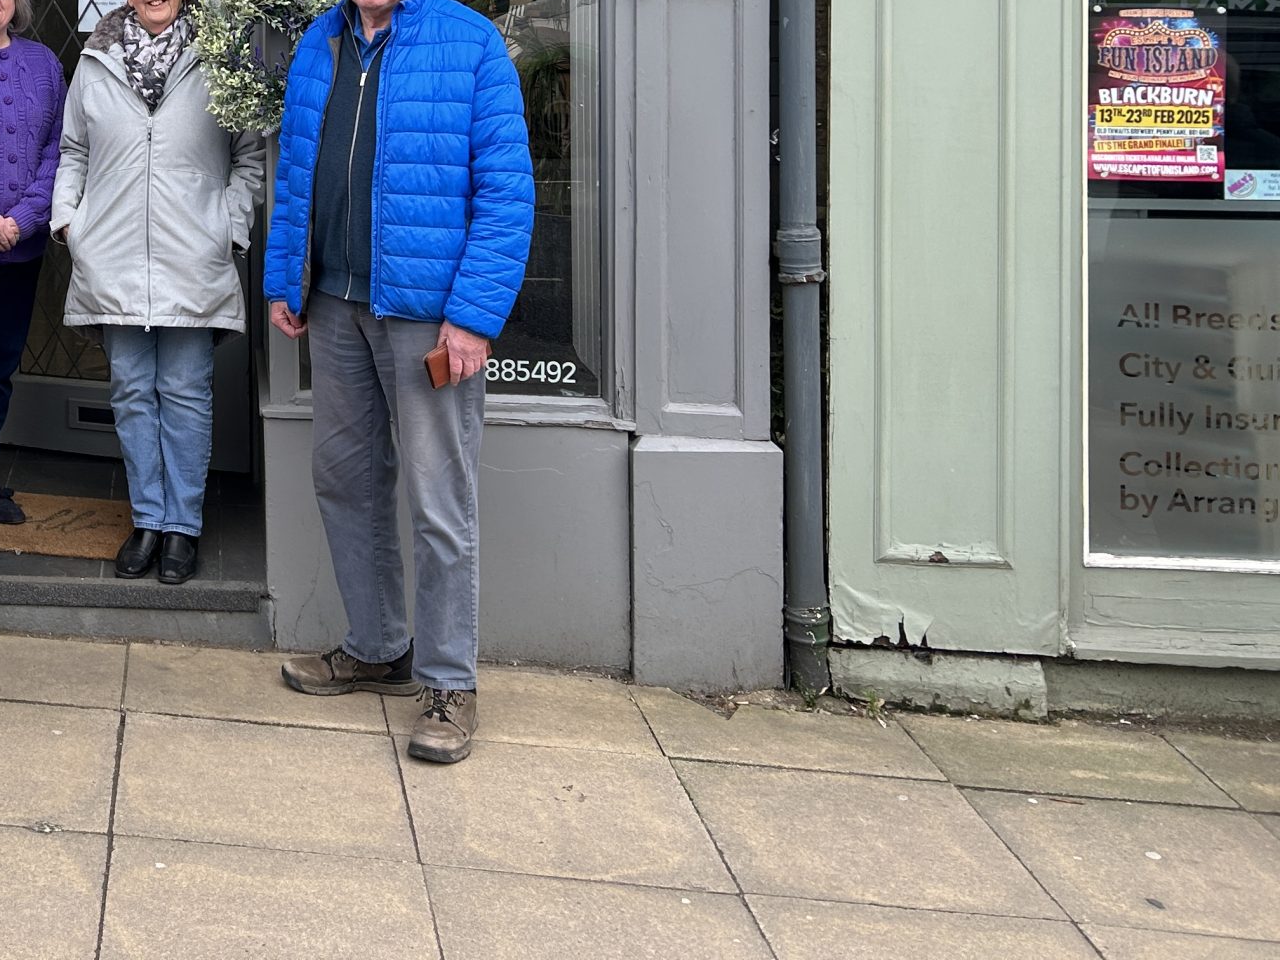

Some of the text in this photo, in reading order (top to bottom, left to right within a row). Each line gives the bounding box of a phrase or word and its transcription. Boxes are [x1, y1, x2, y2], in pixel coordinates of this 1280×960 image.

[1098, 44, 1217, 73] FUN ISLAND
[1098, 86, 1214, 106] BLACKBURN
[1099, 108, 1210, 125] 13TH-23RD FEB 2025
[1113, 141, 1127, 150] THE
[1128, 140, 1154, 150] GRAND
[1117, 302, 1160, 329] All
[484, 358, 577, 384] 885492
[1119, 352, 1181, 384] City
[1192, 354, 1217, 380] &
[1120, 401, 1195, 436] Fully
[1120, 484, 1158, 519] by
